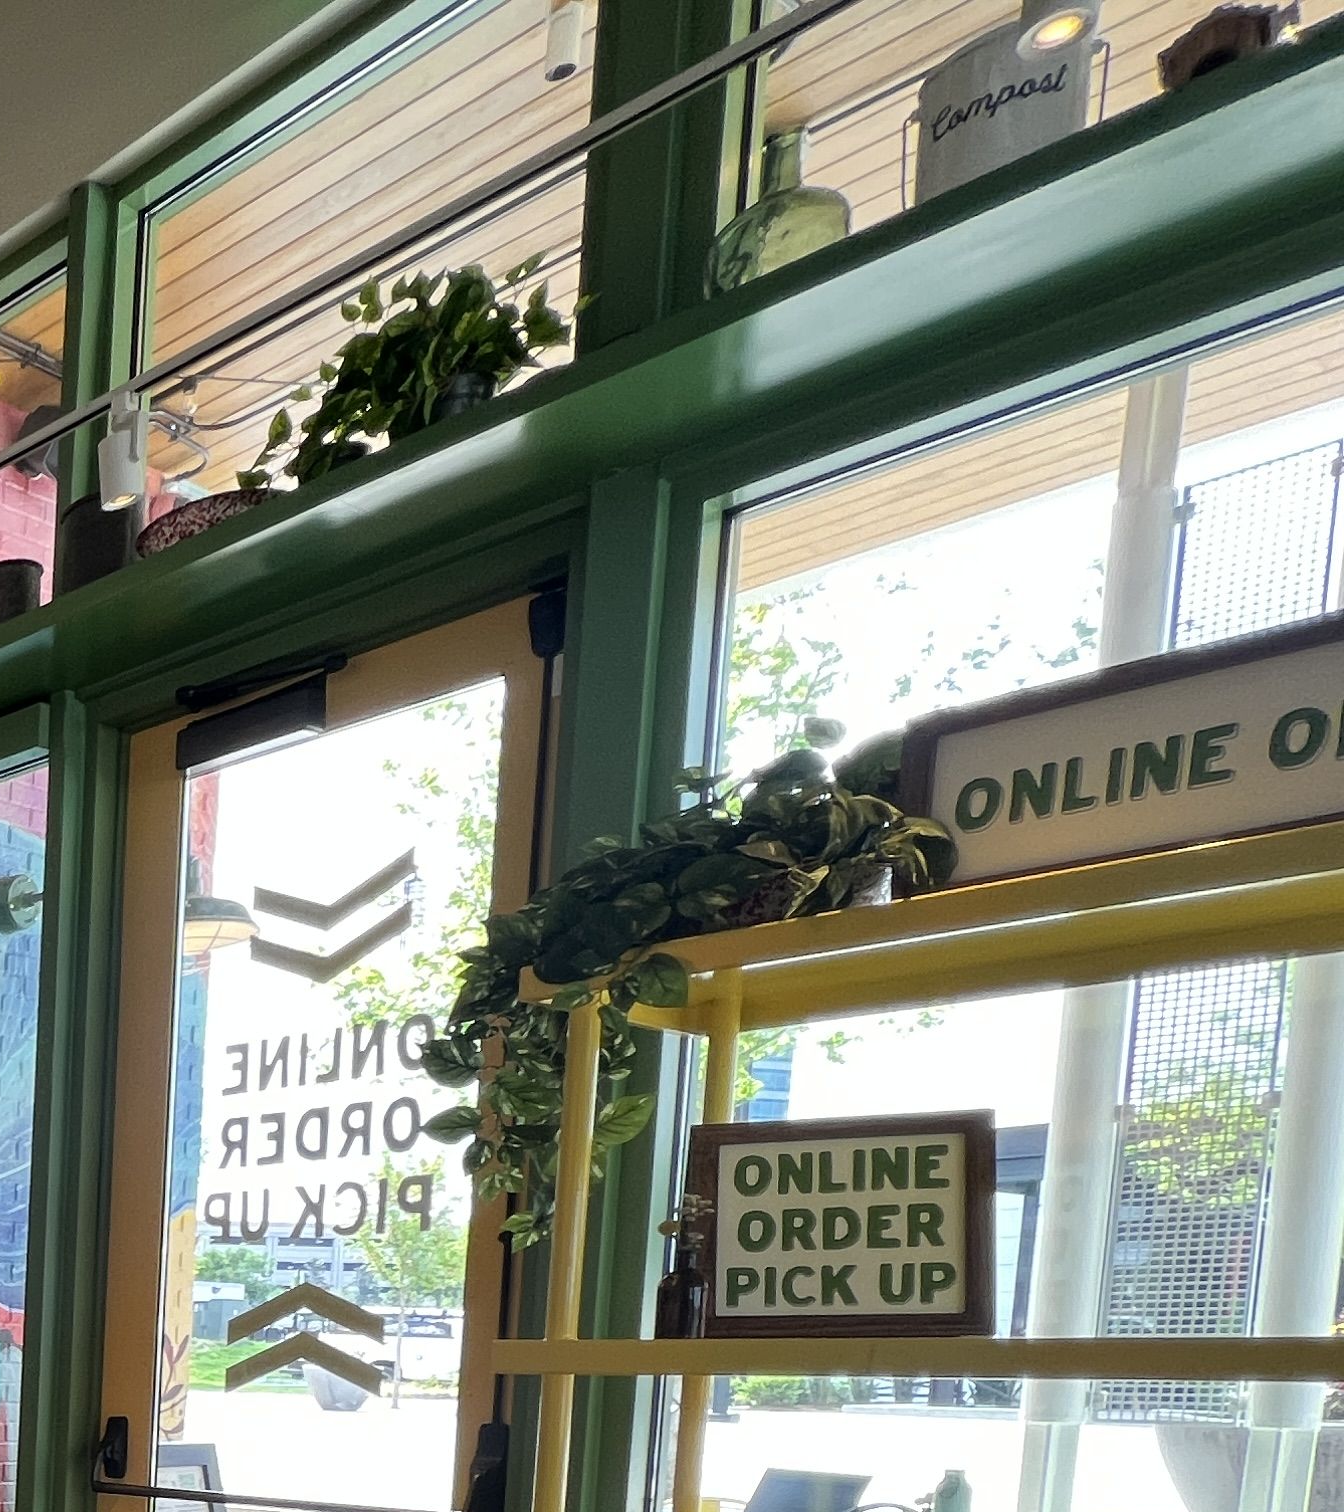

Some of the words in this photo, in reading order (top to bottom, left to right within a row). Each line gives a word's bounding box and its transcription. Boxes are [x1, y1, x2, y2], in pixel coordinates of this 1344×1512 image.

[954, 722, 1239, 833] ONLINE
[734, 1144, 950, 1197] ONLINE
[736, 1204, 945, 1252] ORDER
[726, 1263, 858, 1308] PICK
[878, 1263, 956, 1305] UP
